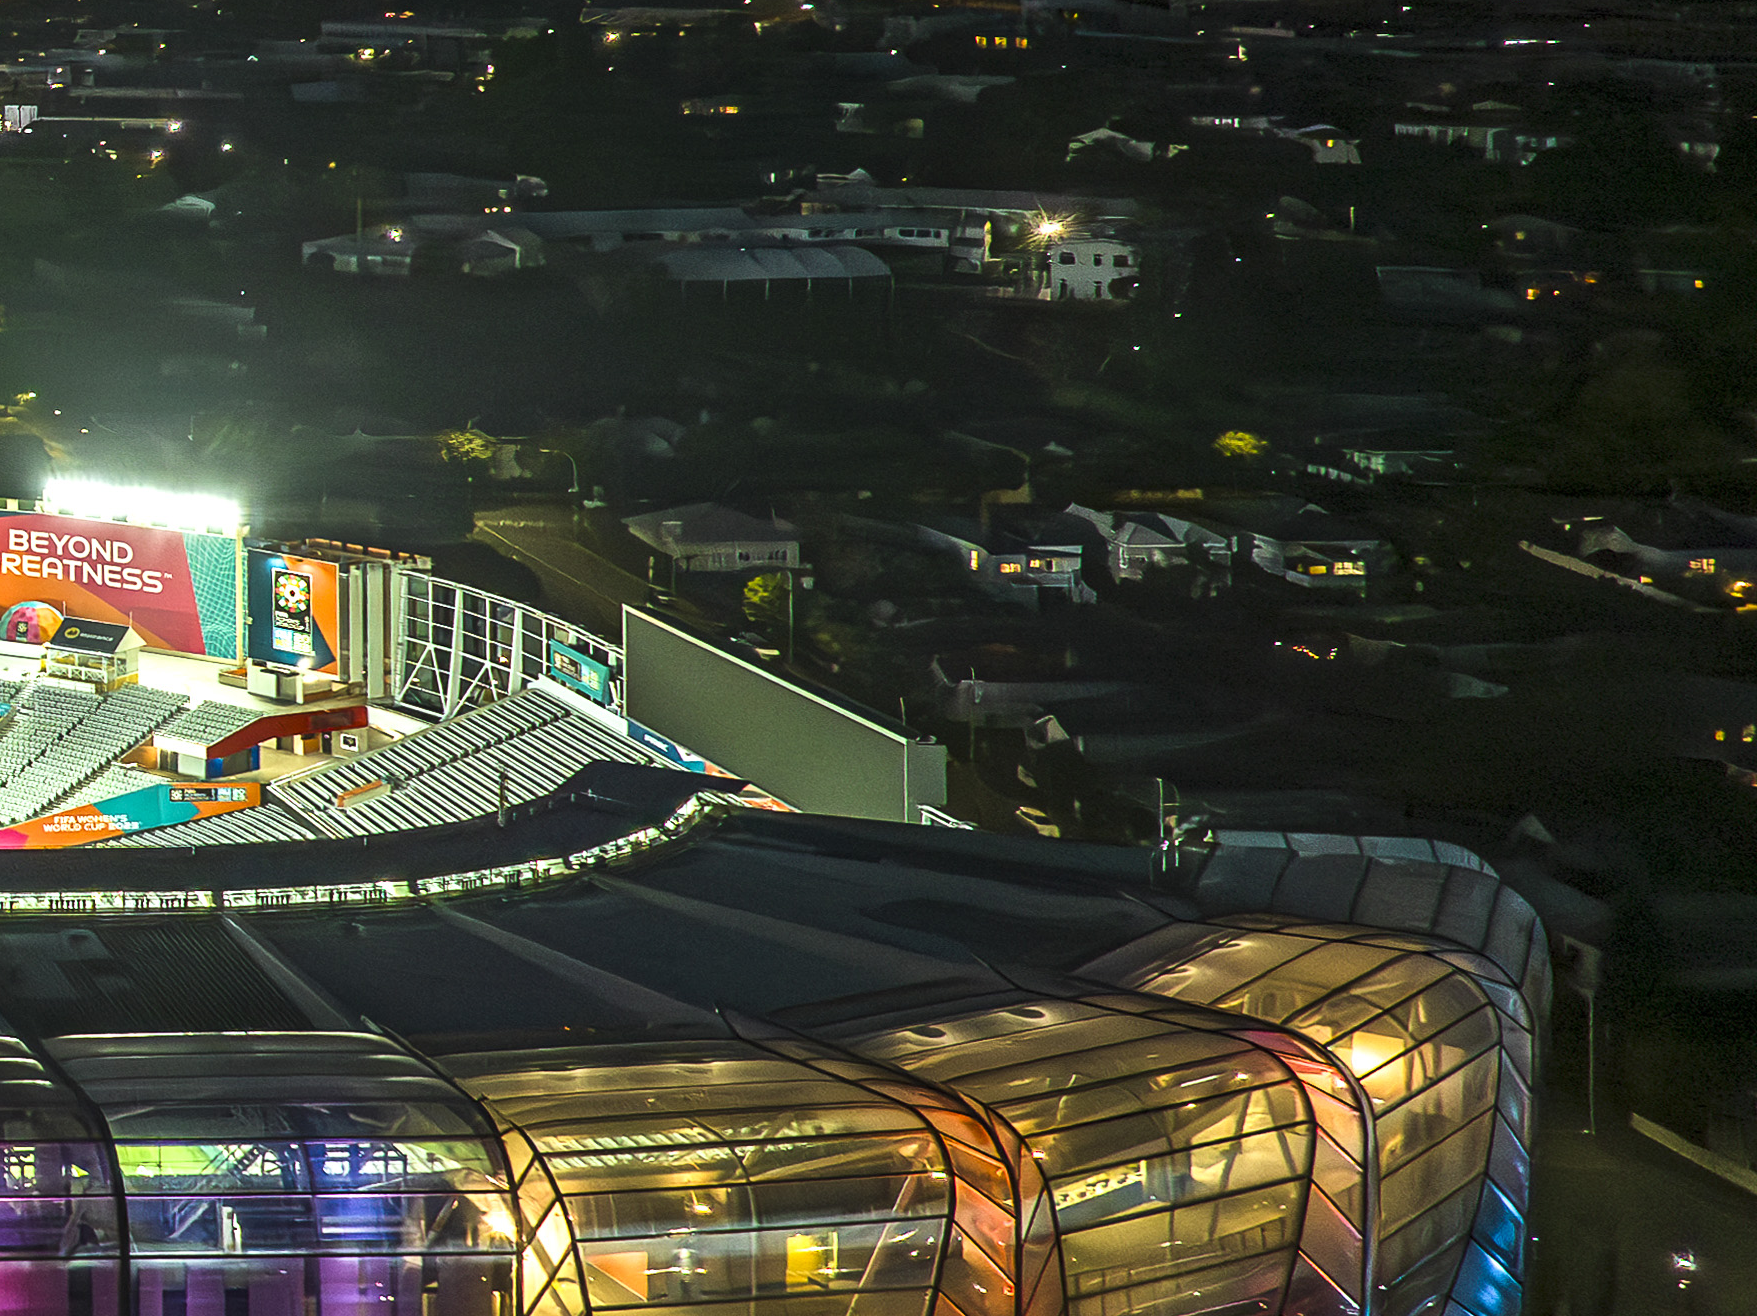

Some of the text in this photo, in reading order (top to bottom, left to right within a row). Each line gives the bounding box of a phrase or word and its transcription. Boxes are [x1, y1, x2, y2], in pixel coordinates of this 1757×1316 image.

[8, 528, 133, 565] BEYOND
[53, 814, 128, 824] FIFA WOMEN'S
[42, 823, 82, 833] WORLD
[84, 822, 106, 831] CUP
